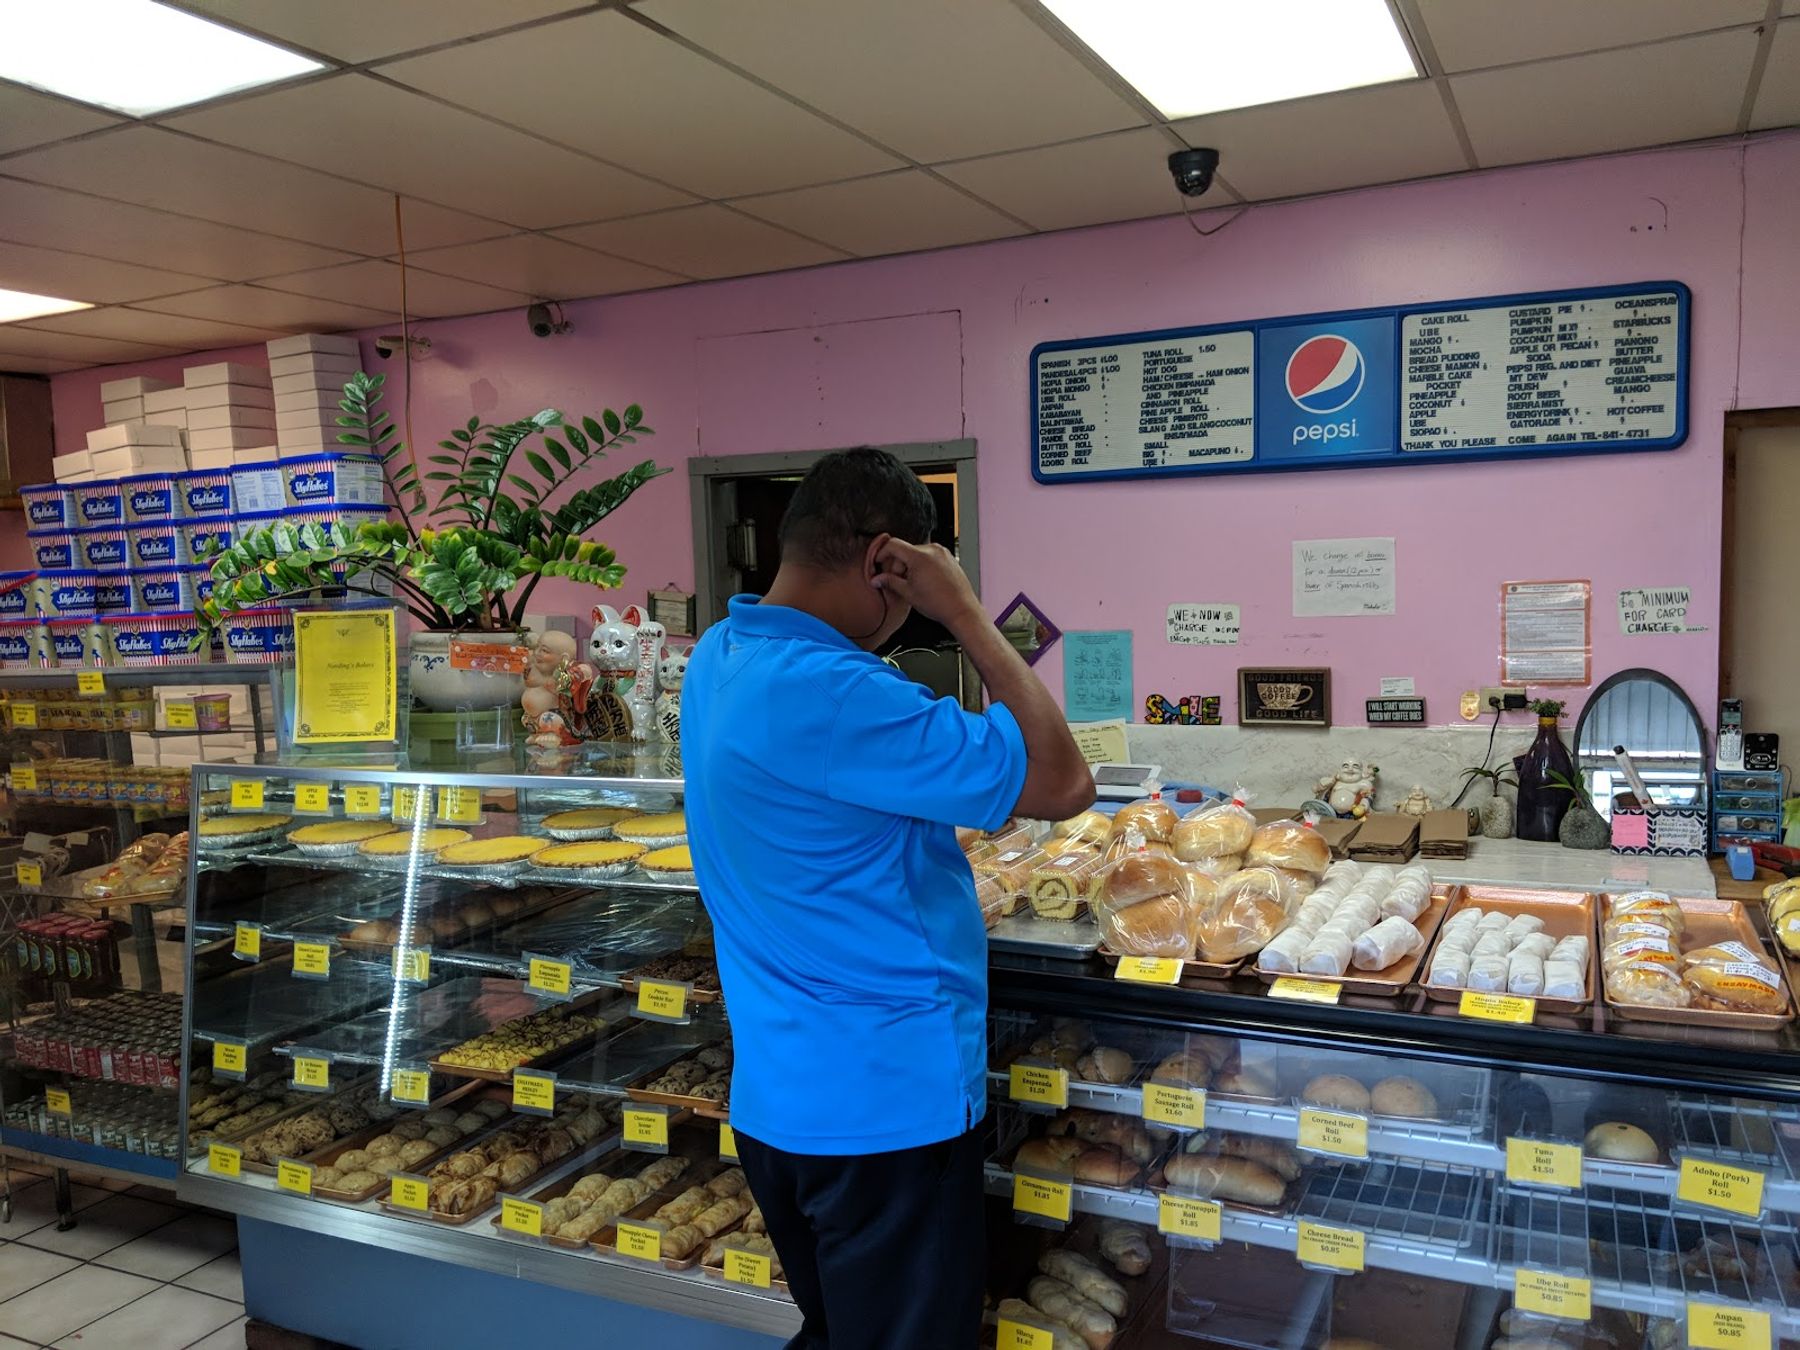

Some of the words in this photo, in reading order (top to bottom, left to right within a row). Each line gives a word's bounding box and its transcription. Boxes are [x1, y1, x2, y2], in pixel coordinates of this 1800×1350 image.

[1509, 307, 1551, 318] CUSTARD
[1558, 305, 1572, 314] PIE
[1421, 316, 1445, 325] CAKE
[1447, 314, 1470, 323] ROLL
[1510, 316, 1553, 327] PUMPKIN
[1613, 316, 1671, 328] STARBUCKS
[1419, 328, 1439, 337] UBE
[1510, 326, 1552, 336] PUMPKIN
[1410, 337, 1443, 346] MANGO
[1510, 334, 1554, 345] COCONUT
[1409, 346, 1442, 355] MOCHA
[1510, 345, 1539, 355] APPLE
[1543, 344, 1556, 352] OR
[1560, 341, 1591, 351] PECAN
[1616, 346, 1654, 356] BUTTER
[1142, 350, 1162, 359] TUNA
[1165, 348, 1184, 356] ROLL
[1409, 356, 1438, 365] BREAD
[1441, 352, 1480, 362] PUDDING
[1526, 353, 1552, 362] SODA
[1041, 360, 1071, 369] SPANISH
[1144, 355, 1193, 367] PORTUGUESE
[1609, 355, 1662, 366] PINEAPPLE
[1143, 367, 1158, 375] HOT
[1161, 365, 1177, 374] DOG
[1409, 364, 1442, 373] CHEESE
[1445, 361, 1480, 371] MAMON
[1506, 364, 1533, 373] PEPSI
[1559, 361, 1579, 370] AND
[1581, 359, 1602, 368] DIET
[1614, 366, 1646, 375] GUAVA
[1164, 372, 1194, 380] CHEESE
[1206, 369, 1224, 377] HAM
[1225, 367, 1250, 376] ONION
[1409, 373, 1444, 383] MARBLE
[1448, 371, 1472, 380] CAKE
[1509, 374, 1523, 382] MT
[1527, 372, 1548, 381] DEW
[1041, 379, 1062, 387] HOPIA
[1065, 376, 1087, 385] ONION
[1142, 383, 1174, 392] CHICKEN
[1176, 379, 1215, 389] EMPANADA
[1426, 381, 1461, 390] POCKET
[1041, 387, 1062, 395] HOPIA
[1507, 382, 1539, 392] CRUSH
[1614, 384, 1651, 394] MANGO
[1058, 394, 1076, 402] ROLL
[1146, 392, 1162, 400] AND
[1168, 388, 1209, 398] PINEAPPLE
[1409, 390, 1457, 400] PINEAPPLE
[1507, 392, 1533, 401] ROOT
[1537, 390, 1560, 399] BEER
[1141, 399, 1180, 408] CINNAMON
[1183, 397, 1202, 405] ROLL
[1409, 400, 1452, 409] COCONUT
[1191, 405, 1209, 413] ROLL
[1409, 410, 1437, 418] APPLE
[1607, 407, 1625, 416] HOT
[1627, 405, 1664, 414] COFFEE
[1140, 417, 1168, 425] CHEESE
[1410, 419, 1426, 427] UBE
[1510, 418, 1560, 428] GATORADE
[1040, 427, 1066, 435] CHEESE
[1072, 424, 1095, 433] BREAD
[1170, 423, 1186, 431] AND
[1293, 418, 1356, 446] pepsi
[1410, 427, 1441, 436] SIOPAO
[1069, 433, 1089, 441] COCO
[1405, 441, 1434, 450] THANK
[1439, 440, 1457, 448] YOU
[1462, 437, 1496, 447] PLEASE
[1508, 435, 1536, 444] COME
[1546, 433, 1577, 442] AGAIN
[1041, 443, 1068, 451] BUTTER
[1144, 441, 1169, 449] SMALL
[1041, 451, 1068, 459] CORNED
[1189, 447, 1231, 457] MACAPUNO
[1041, 459, 1065, 467] ADOBO
[1071, 457, 1089, 465] ROLL
[1641, 591, 1689, 607] MINIMUM
[1174, 609, 1189, 621] WE
[1200, 609, 1221, 621] NOW
[1624, 610, 1647, 622] FOR
[1656, 608, 1687, 619] CARD
[1174, 623, 1207, 632] CHARGE
[1627, 622, 1673, 633] CHARGE
[1144, 694, 1222, 725] SMILE
[1256, 710, 1287, 718] GOOD
[1293, 710, 1318, 718] LIFE
[1392, 711, 1409, 720] COFFEE
[1026, 1071, 1049, 1079] Chicken
[1022, 1078, 1052, 1088] Empanada
[1157, 1090, 1192, 1101] Portuguese
[1155, 1098, 1180, 1108] Sausage
[1165, 1108, 1183, 1116] $1.60
[1311, 1116, 1337, 1127] Corned
[1338, 1119, 1354, 1129] Beef
[1325, 1127, 1339, 1136] Roll
[1322, 1134, 1341, 1144] $1.50
[1534, 1147, 1554, 1156] Tuna
[1535, 1156, 1552, 1165] Roll
[1532, 1164, 1554, 1174] $1.50
[1692, 1166, 1720, 1178] Adobo
[1722, 1171, 1750, 1184] (Pork)
[1022, 1180, 1051, 1192] Cinnamon
[1711, 1179, 1729, 1189] Roll
[1707, 1188, 1732, 1199] $1.50
[1162, 1199, 1184, 1208] Cheese
[1185, 1203, 1217, 1214] Pineapple
[1307, 1228, 1331, 1239] Cheese
[1333, 1232, 1354, 1243] Bread
[1320, 1244, 1340, 1254] $0.85
[1536, 1277, 1552, 1288] Ube
[1553, 1280, 1570, 1289] Roll
[1541, 1293, 1564, 1303] $0.85
[1715, 1312, 1743, 1325] Anpan
[1717, 1328, 1742, 1338] $0.85
